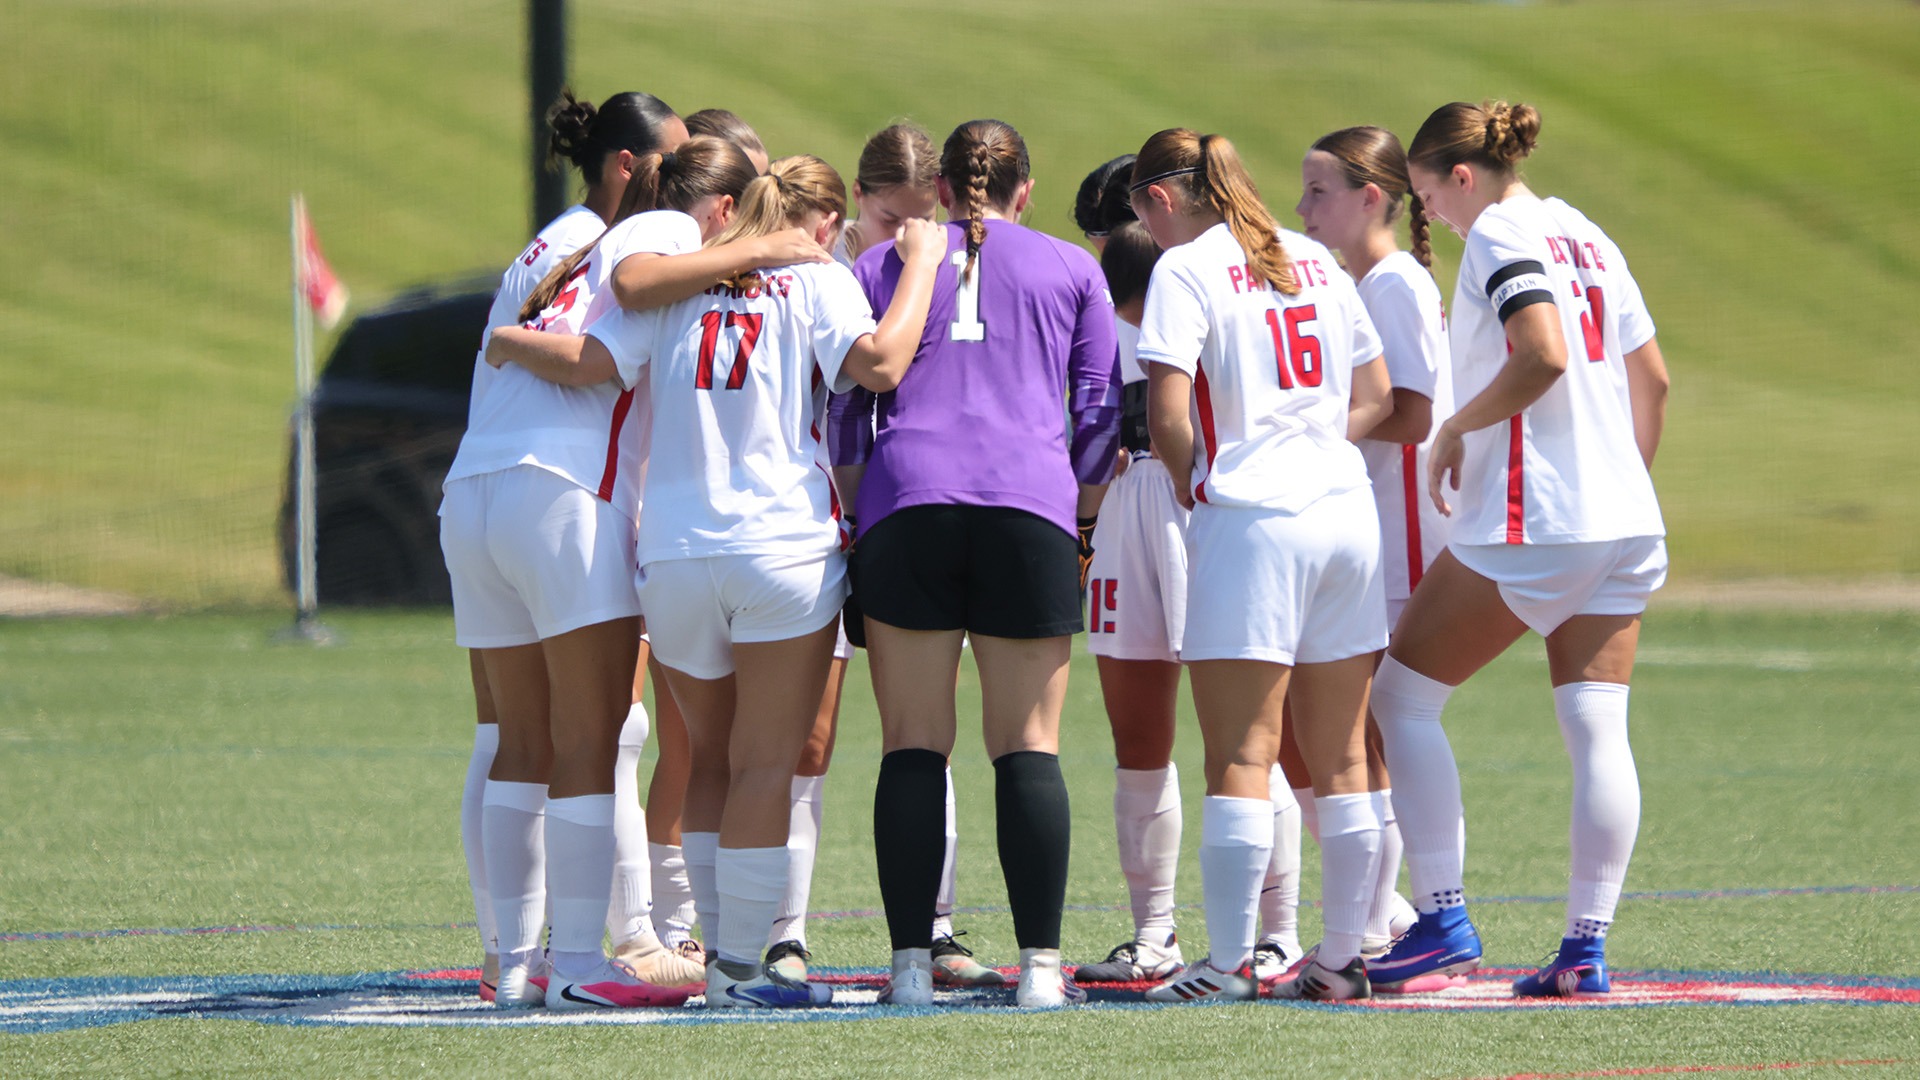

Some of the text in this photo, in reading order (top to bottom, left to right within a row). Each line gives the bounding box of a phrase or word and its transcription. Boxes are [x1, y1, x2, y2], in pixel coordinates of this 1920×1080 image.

[950, 249, 987, 342] 1
[1226, 259, 1329, 294] PAOTS
[1493, 278, 1538, 309] CAPTAIN
[694, 310, 764, 391] 17
[1265, 303, 1323, 390] 16
